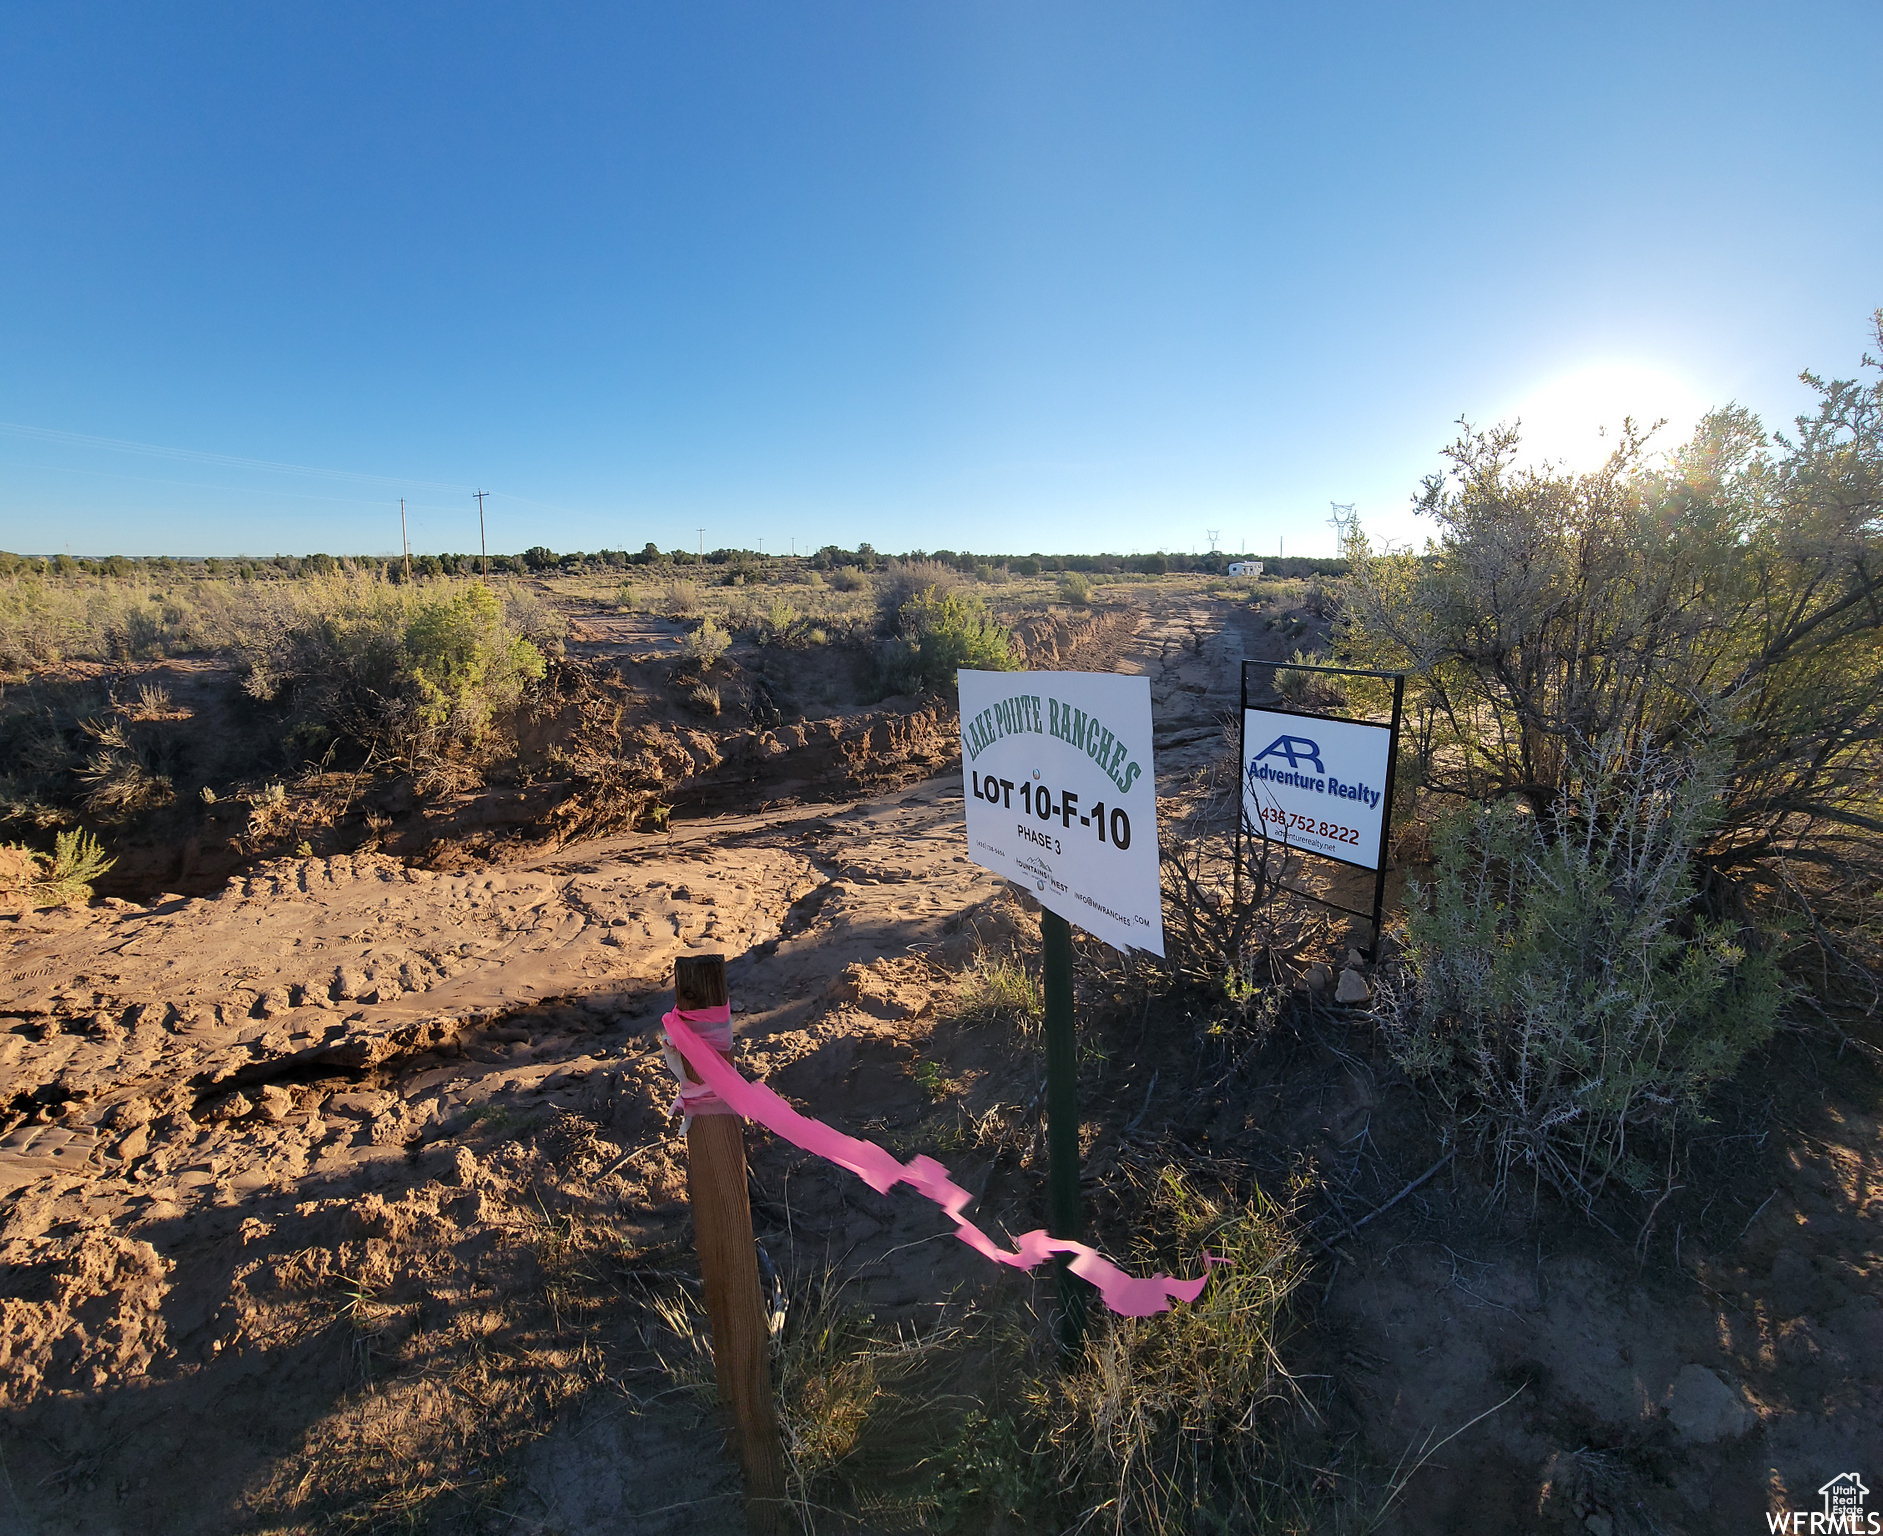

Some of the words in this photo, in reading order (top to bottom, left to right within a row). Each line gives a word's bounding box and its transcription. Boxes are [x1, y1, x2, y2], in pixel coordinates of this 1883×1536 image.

[963, 708, 996, 761] LAKE
[993, 695, 1043, 738] POINTE
[1049, 698, 1142, 793] RANCHES
[1253, 735, 1325, 774] AR
[1249, 761, 1325, 793] Adventure
[1328, 777, 1381, 810] Realty
[972, 770, 1014, 809] LOT
[1020, 781, 1131, 851] 10-F-10
[1261, 807, 1359, 845] 435752.8222
[1018, 824, 1052, 851] PHASE
[1055, 839, 1062, 855] 3
